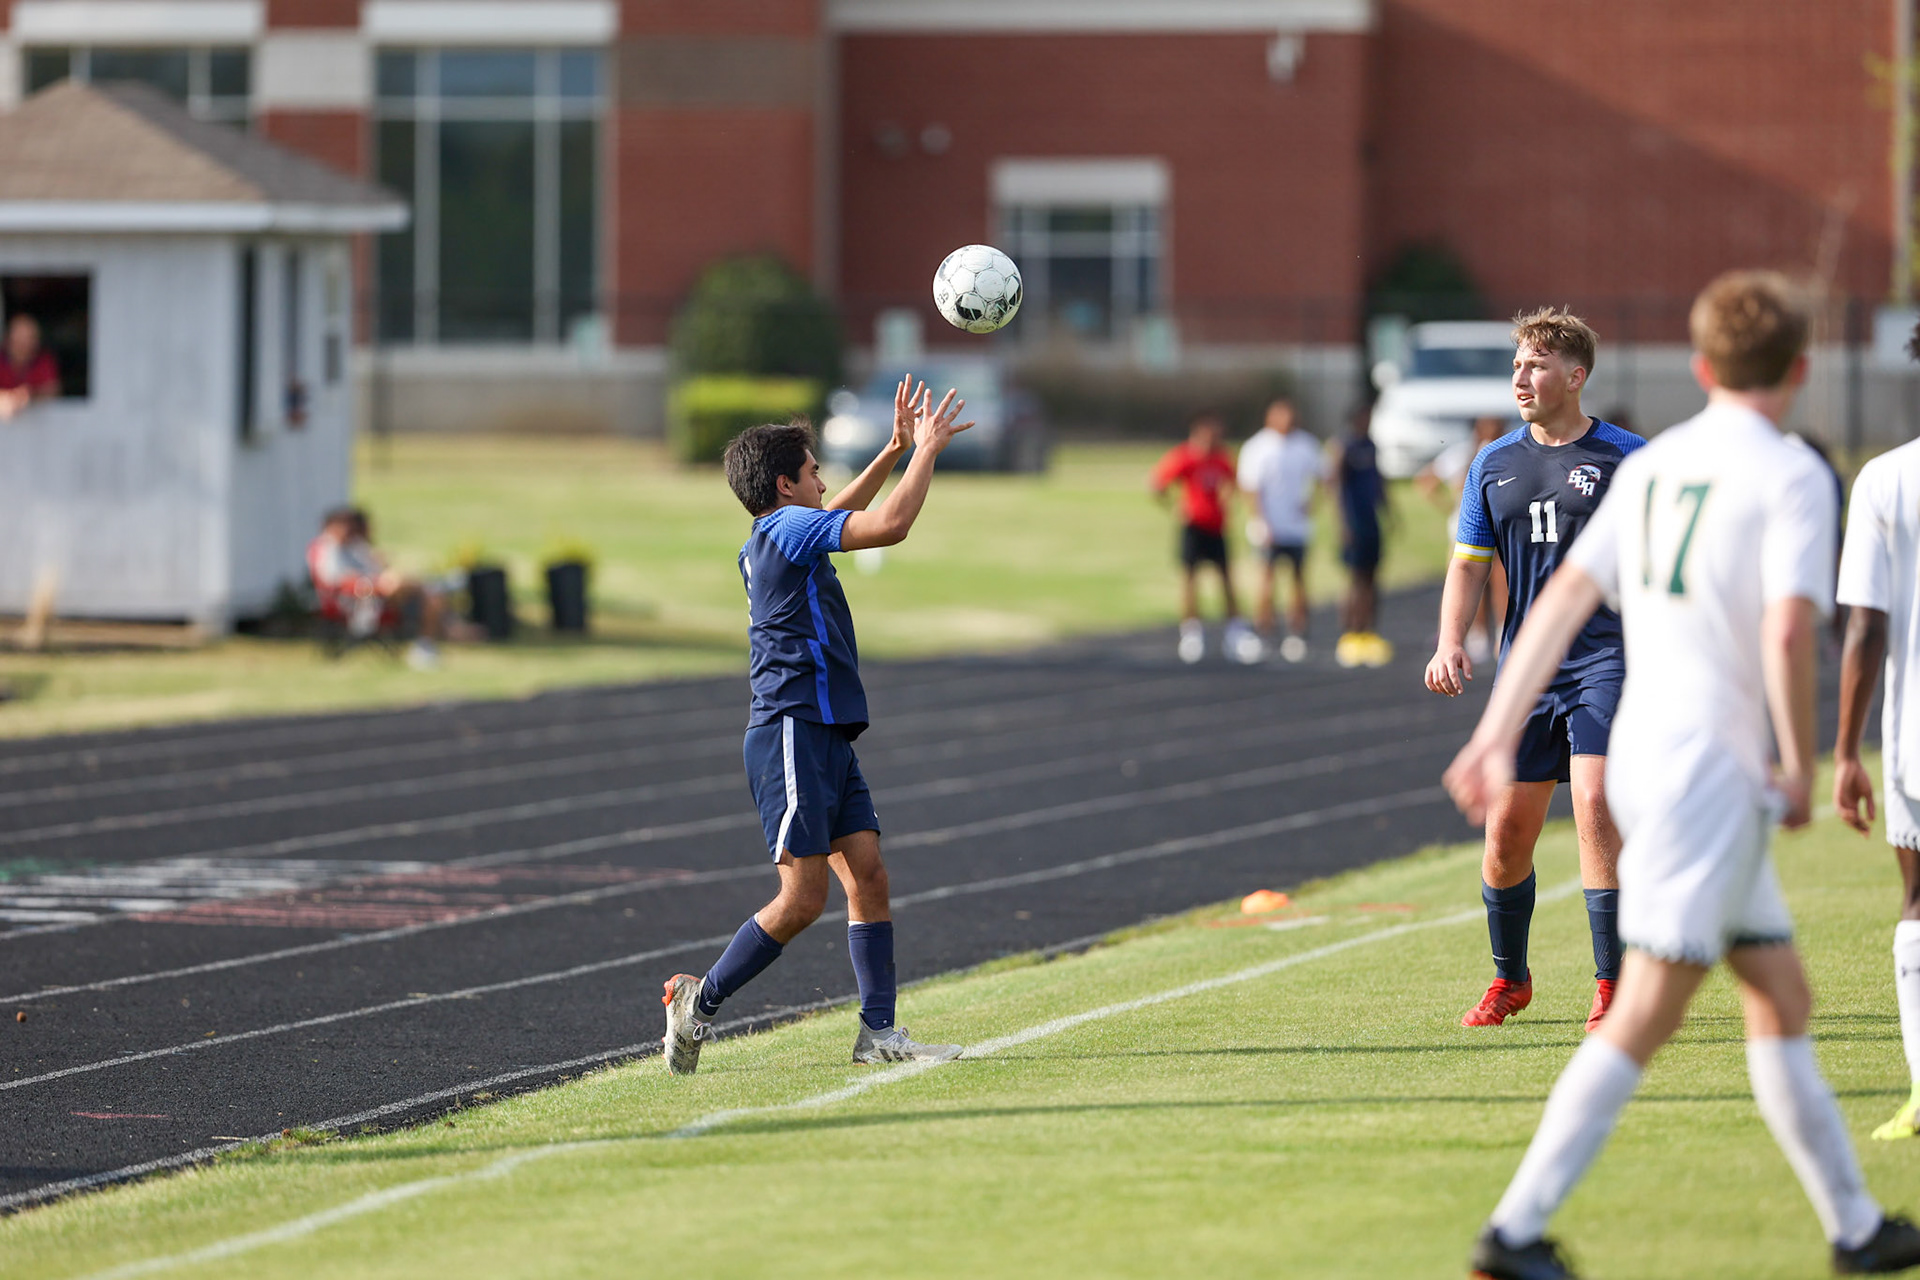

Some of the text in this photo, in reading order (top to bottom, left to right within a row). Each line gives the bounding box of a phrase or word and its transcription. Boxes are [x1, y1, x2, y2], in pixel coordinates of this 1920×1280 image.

[1568, 469, 1596, 496] SBA
[1528, 500, 1558, 543] 11
[1643, 477, 1711, 594] 17
